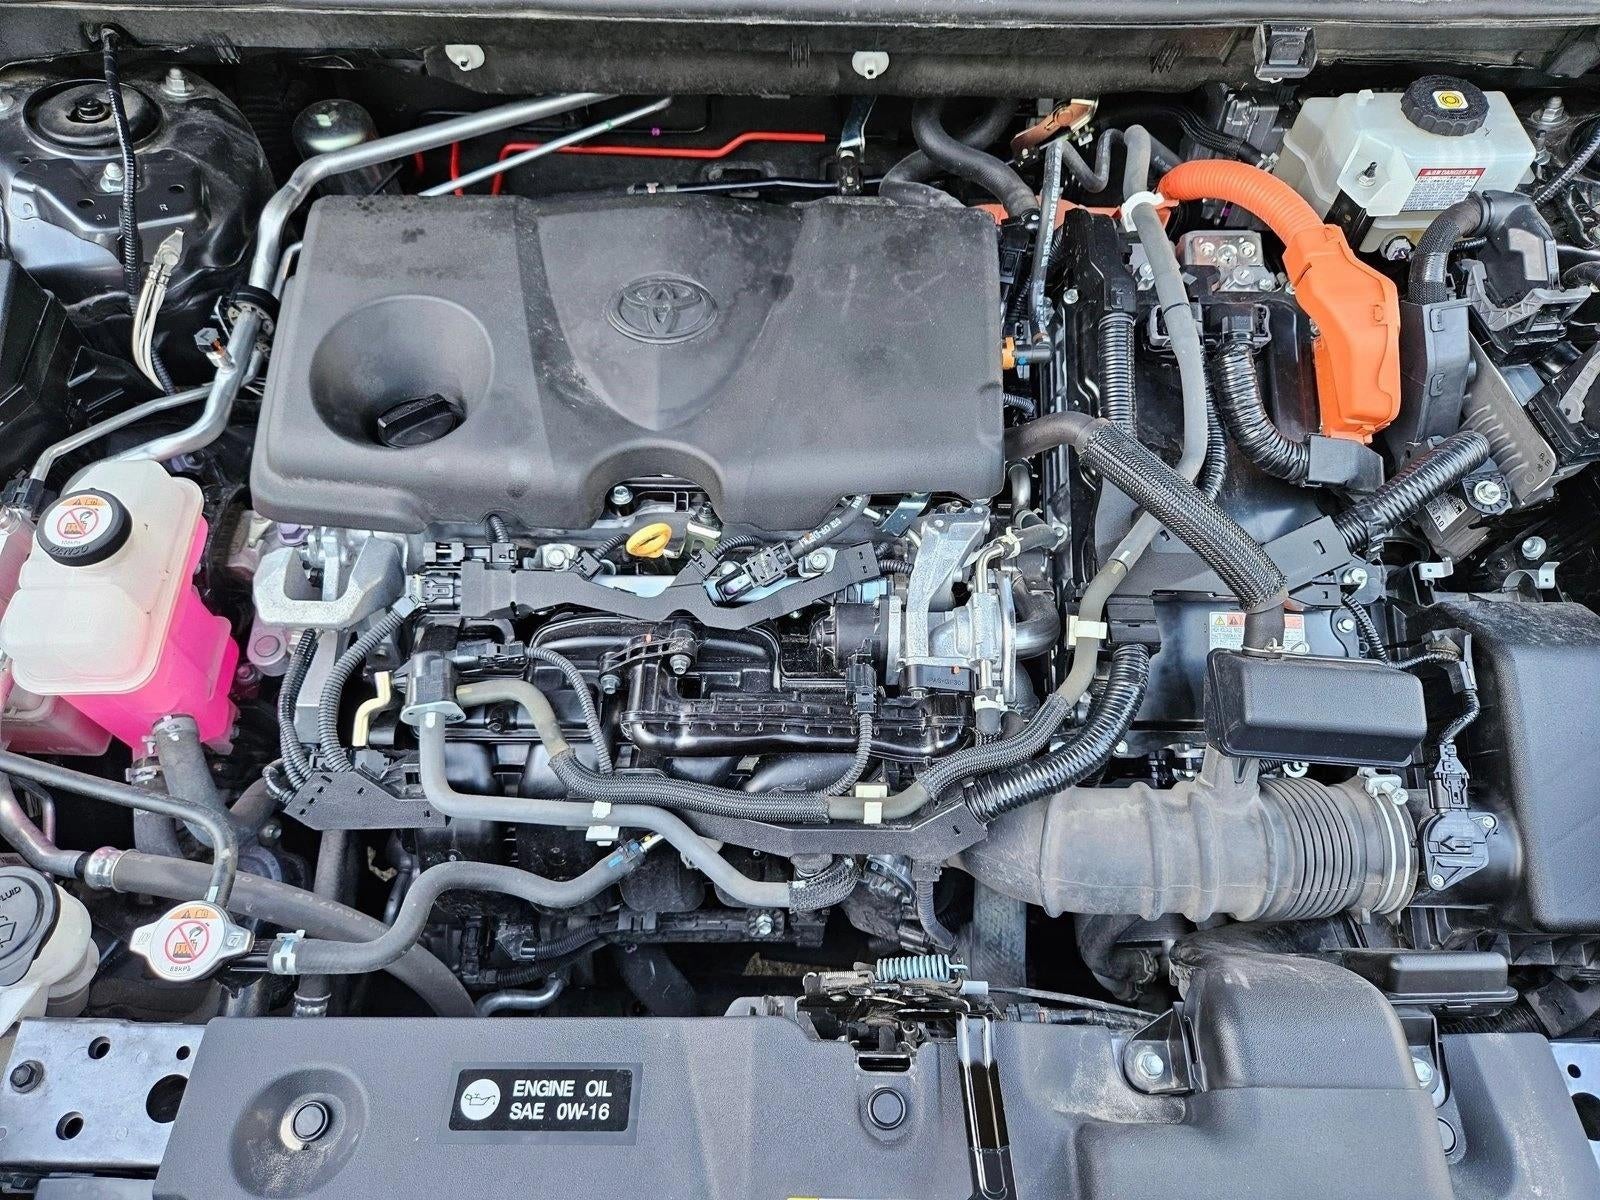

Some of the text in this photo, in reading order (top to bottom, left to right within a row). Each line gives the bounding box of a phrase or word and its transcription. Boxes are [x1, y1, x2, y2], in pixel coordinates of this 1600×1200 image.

[0, 886, 21, 901] LUID
[513, 1080, 612, 1097] ENGINE OIL
[509, 1102, 610, 1121] SAE 0W-16
